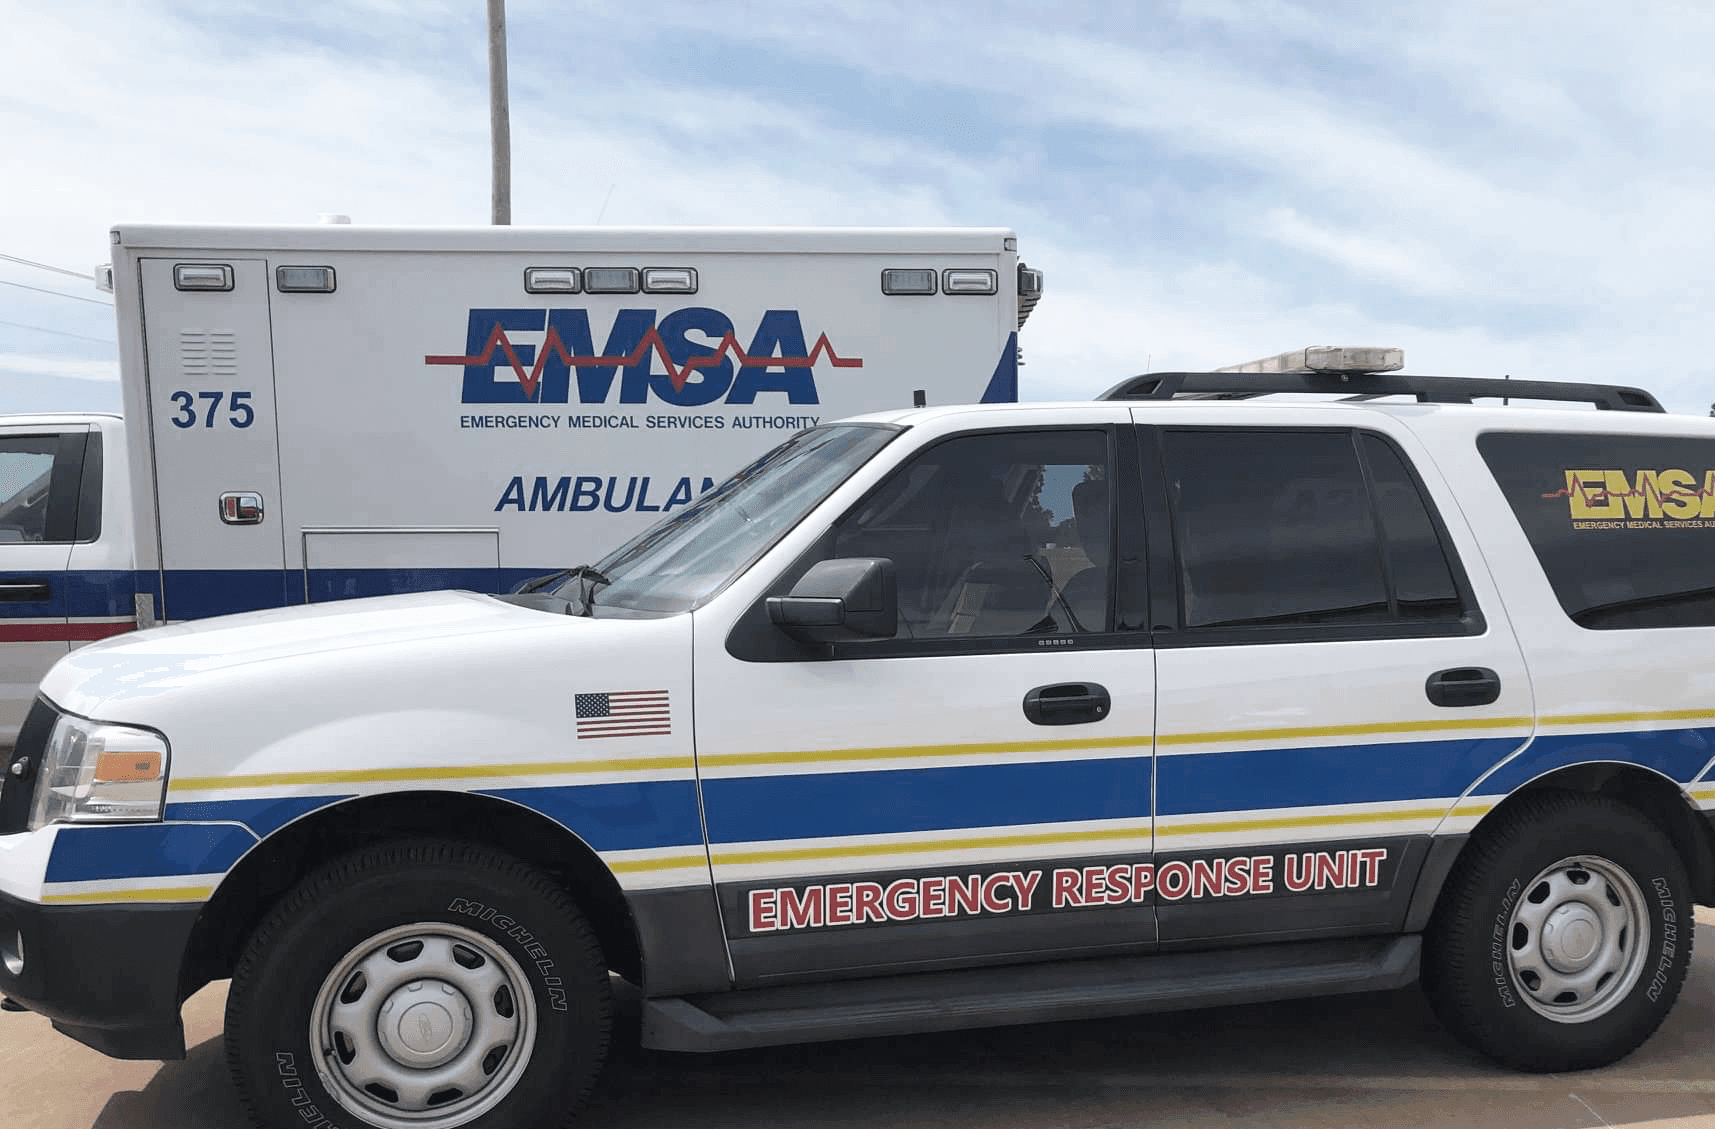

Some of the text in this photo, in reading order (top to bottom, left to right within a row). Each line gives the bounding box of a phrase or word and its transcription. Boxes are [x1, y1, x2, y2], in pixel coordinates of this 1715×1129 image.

[461, 307, 819, 406] EMSA
[171, 390, 254, 428] 375
[460, 415, 820, 429] EMERGENCY MEDICAL SERVICES AUTHORITY
[1573, 521, 1625, 529] EMERGENCY
[1627, 520, 1662, 529] MEDICAL
[1664, 520, 1702, 528] SERVICES
[750, 849, 1386, 931] EMERGENCY RESPONSE UNIT
[447, 897, 568, 1012] MICHELIN
[1646, 877, 1678, 1002] MICHELIN
